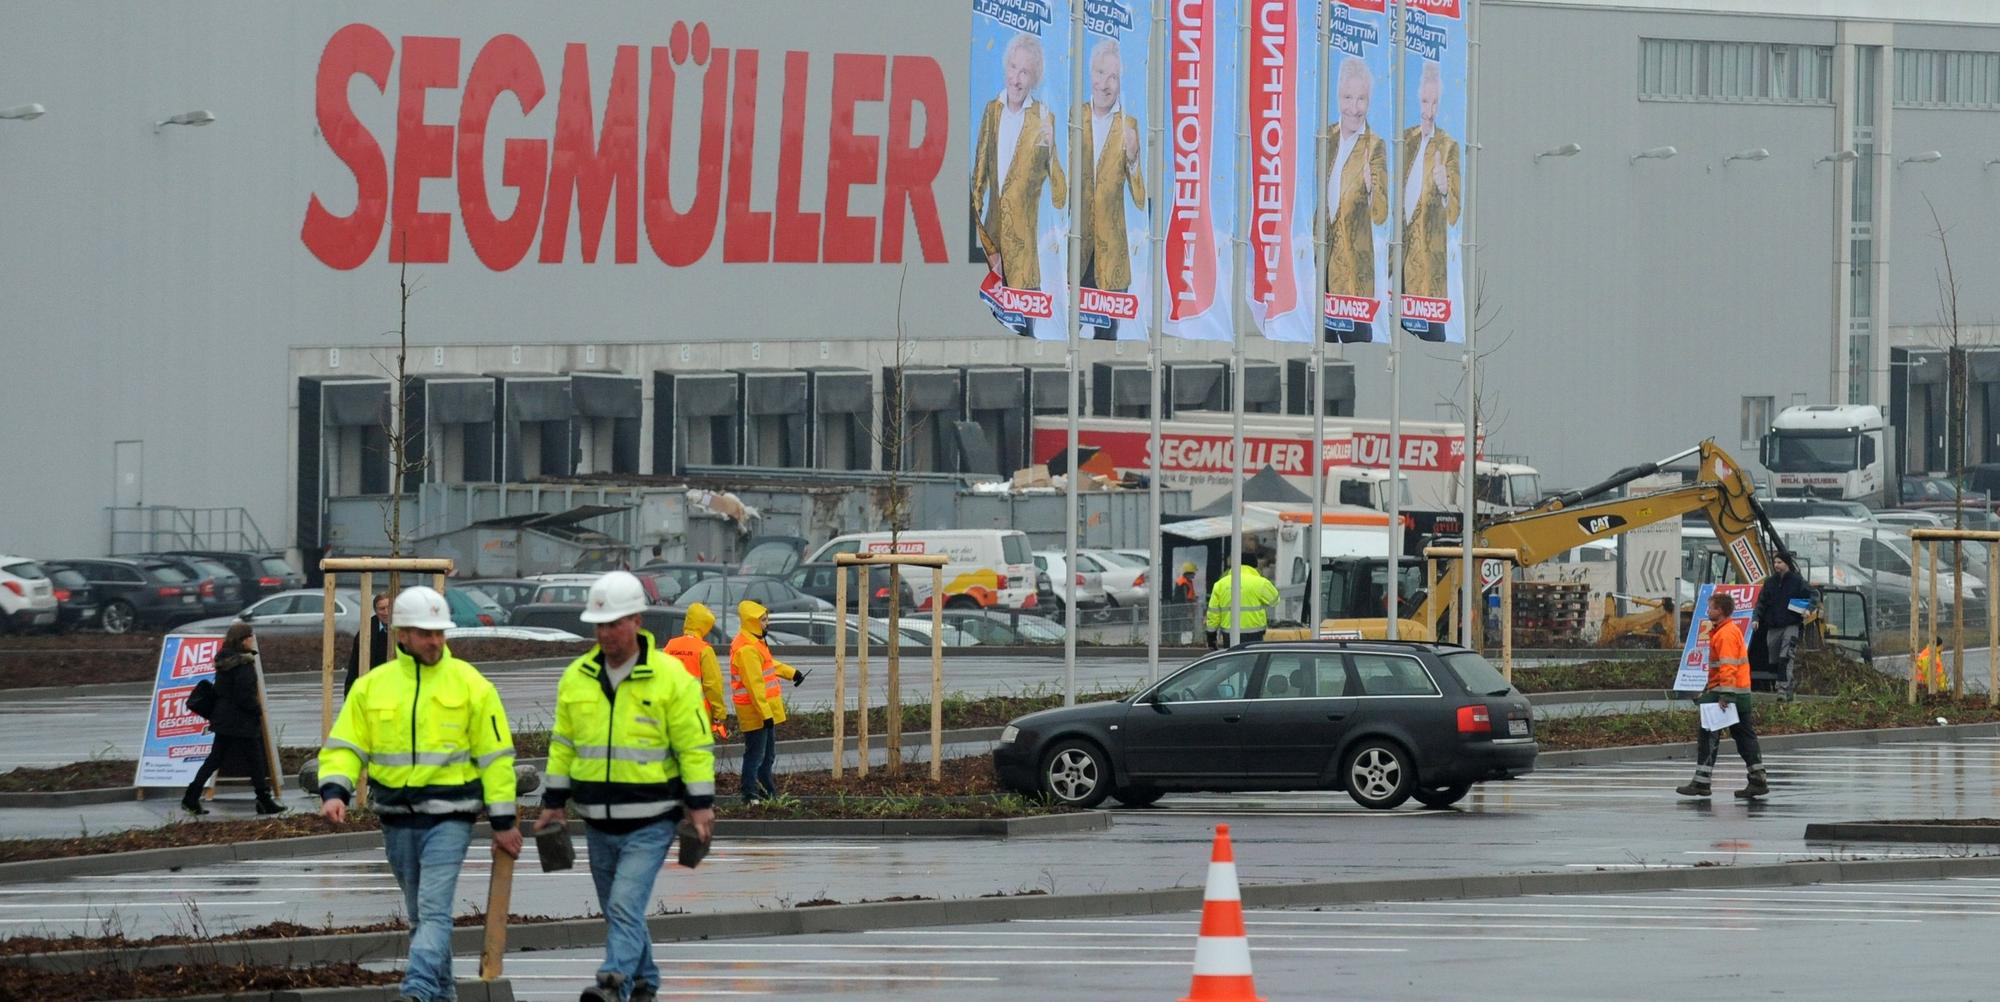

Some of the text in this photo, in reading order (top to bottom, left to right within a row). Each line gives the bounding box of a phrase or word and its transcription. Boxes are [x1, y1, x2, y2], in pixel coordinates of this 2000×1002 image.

[301, 20, 949, 271] SEGMÜLLER
[1142, 437, 1304, 472] SEGMÜLLER
[1590, 516, 1609, 533] CAT
[1484, 562, 1502, 577] 30
[1735, 540, 1761, 580] STRABAG
